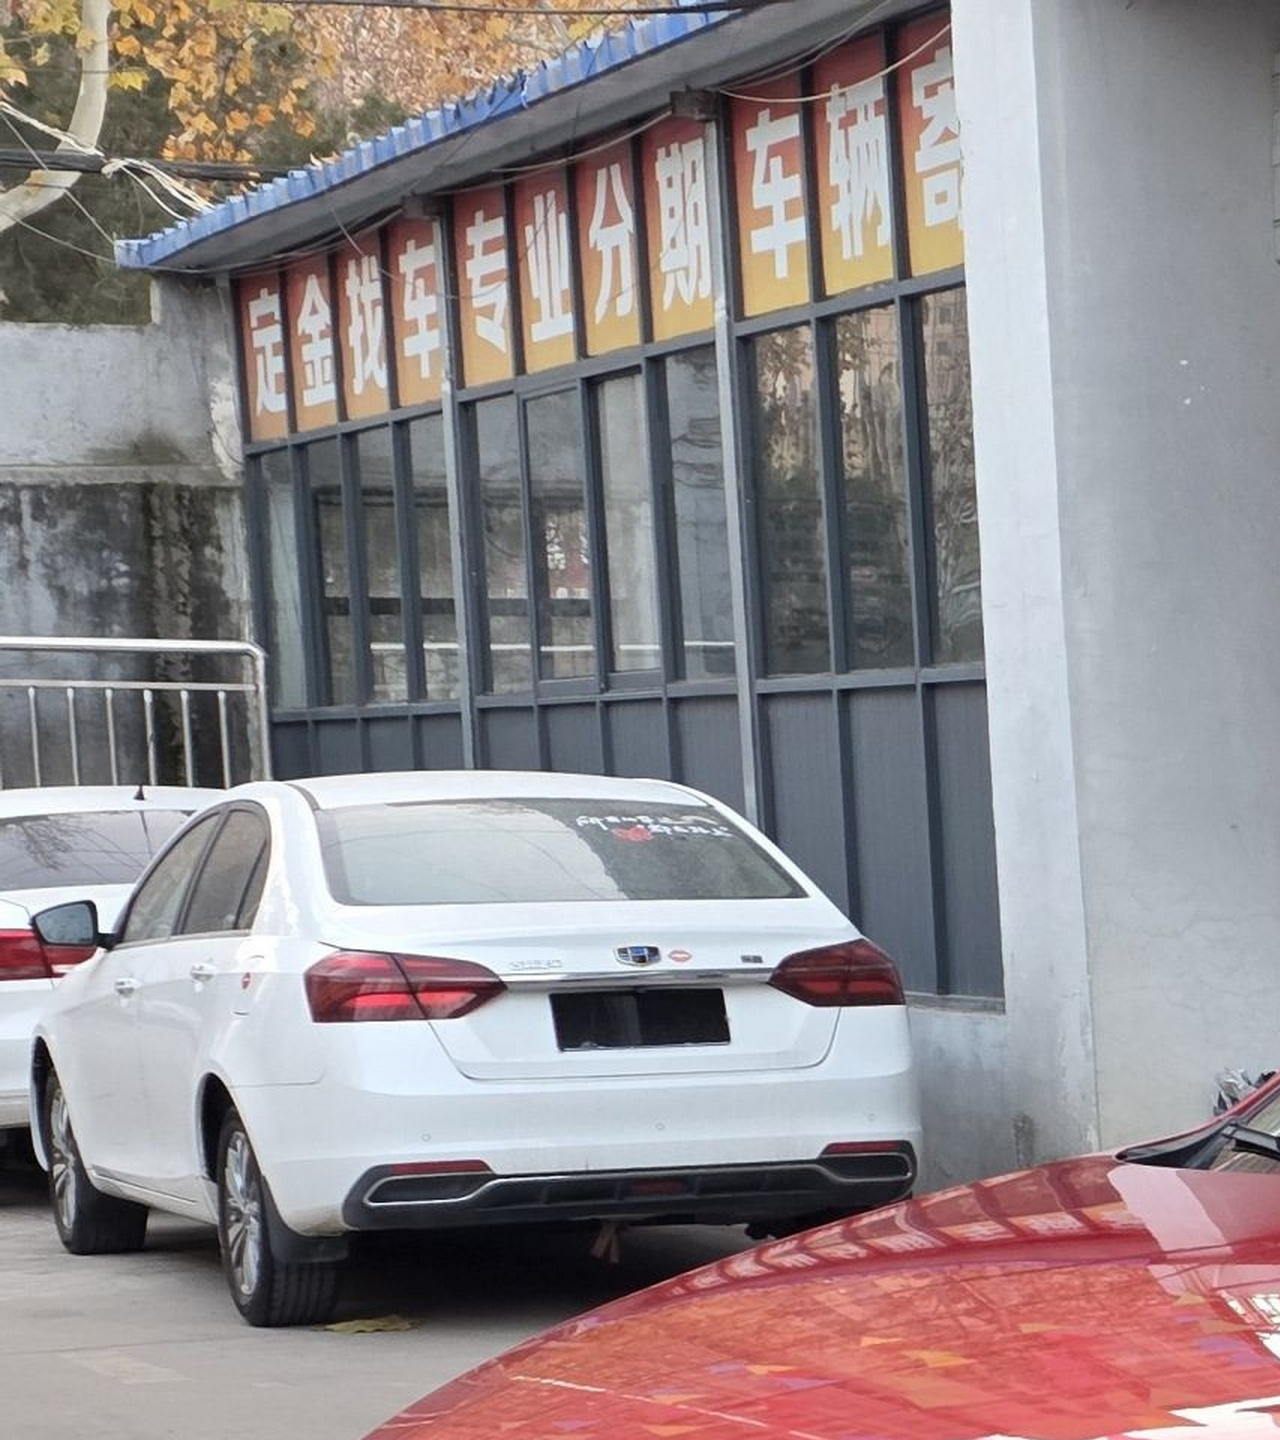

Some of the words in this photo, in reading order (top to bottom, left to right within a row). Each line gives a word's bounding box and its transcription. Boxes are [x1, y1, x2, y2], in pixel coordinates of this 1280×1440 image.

[249, 239, 441, 415] 定金找车
[465, 138, 712, 353] 专业分期
